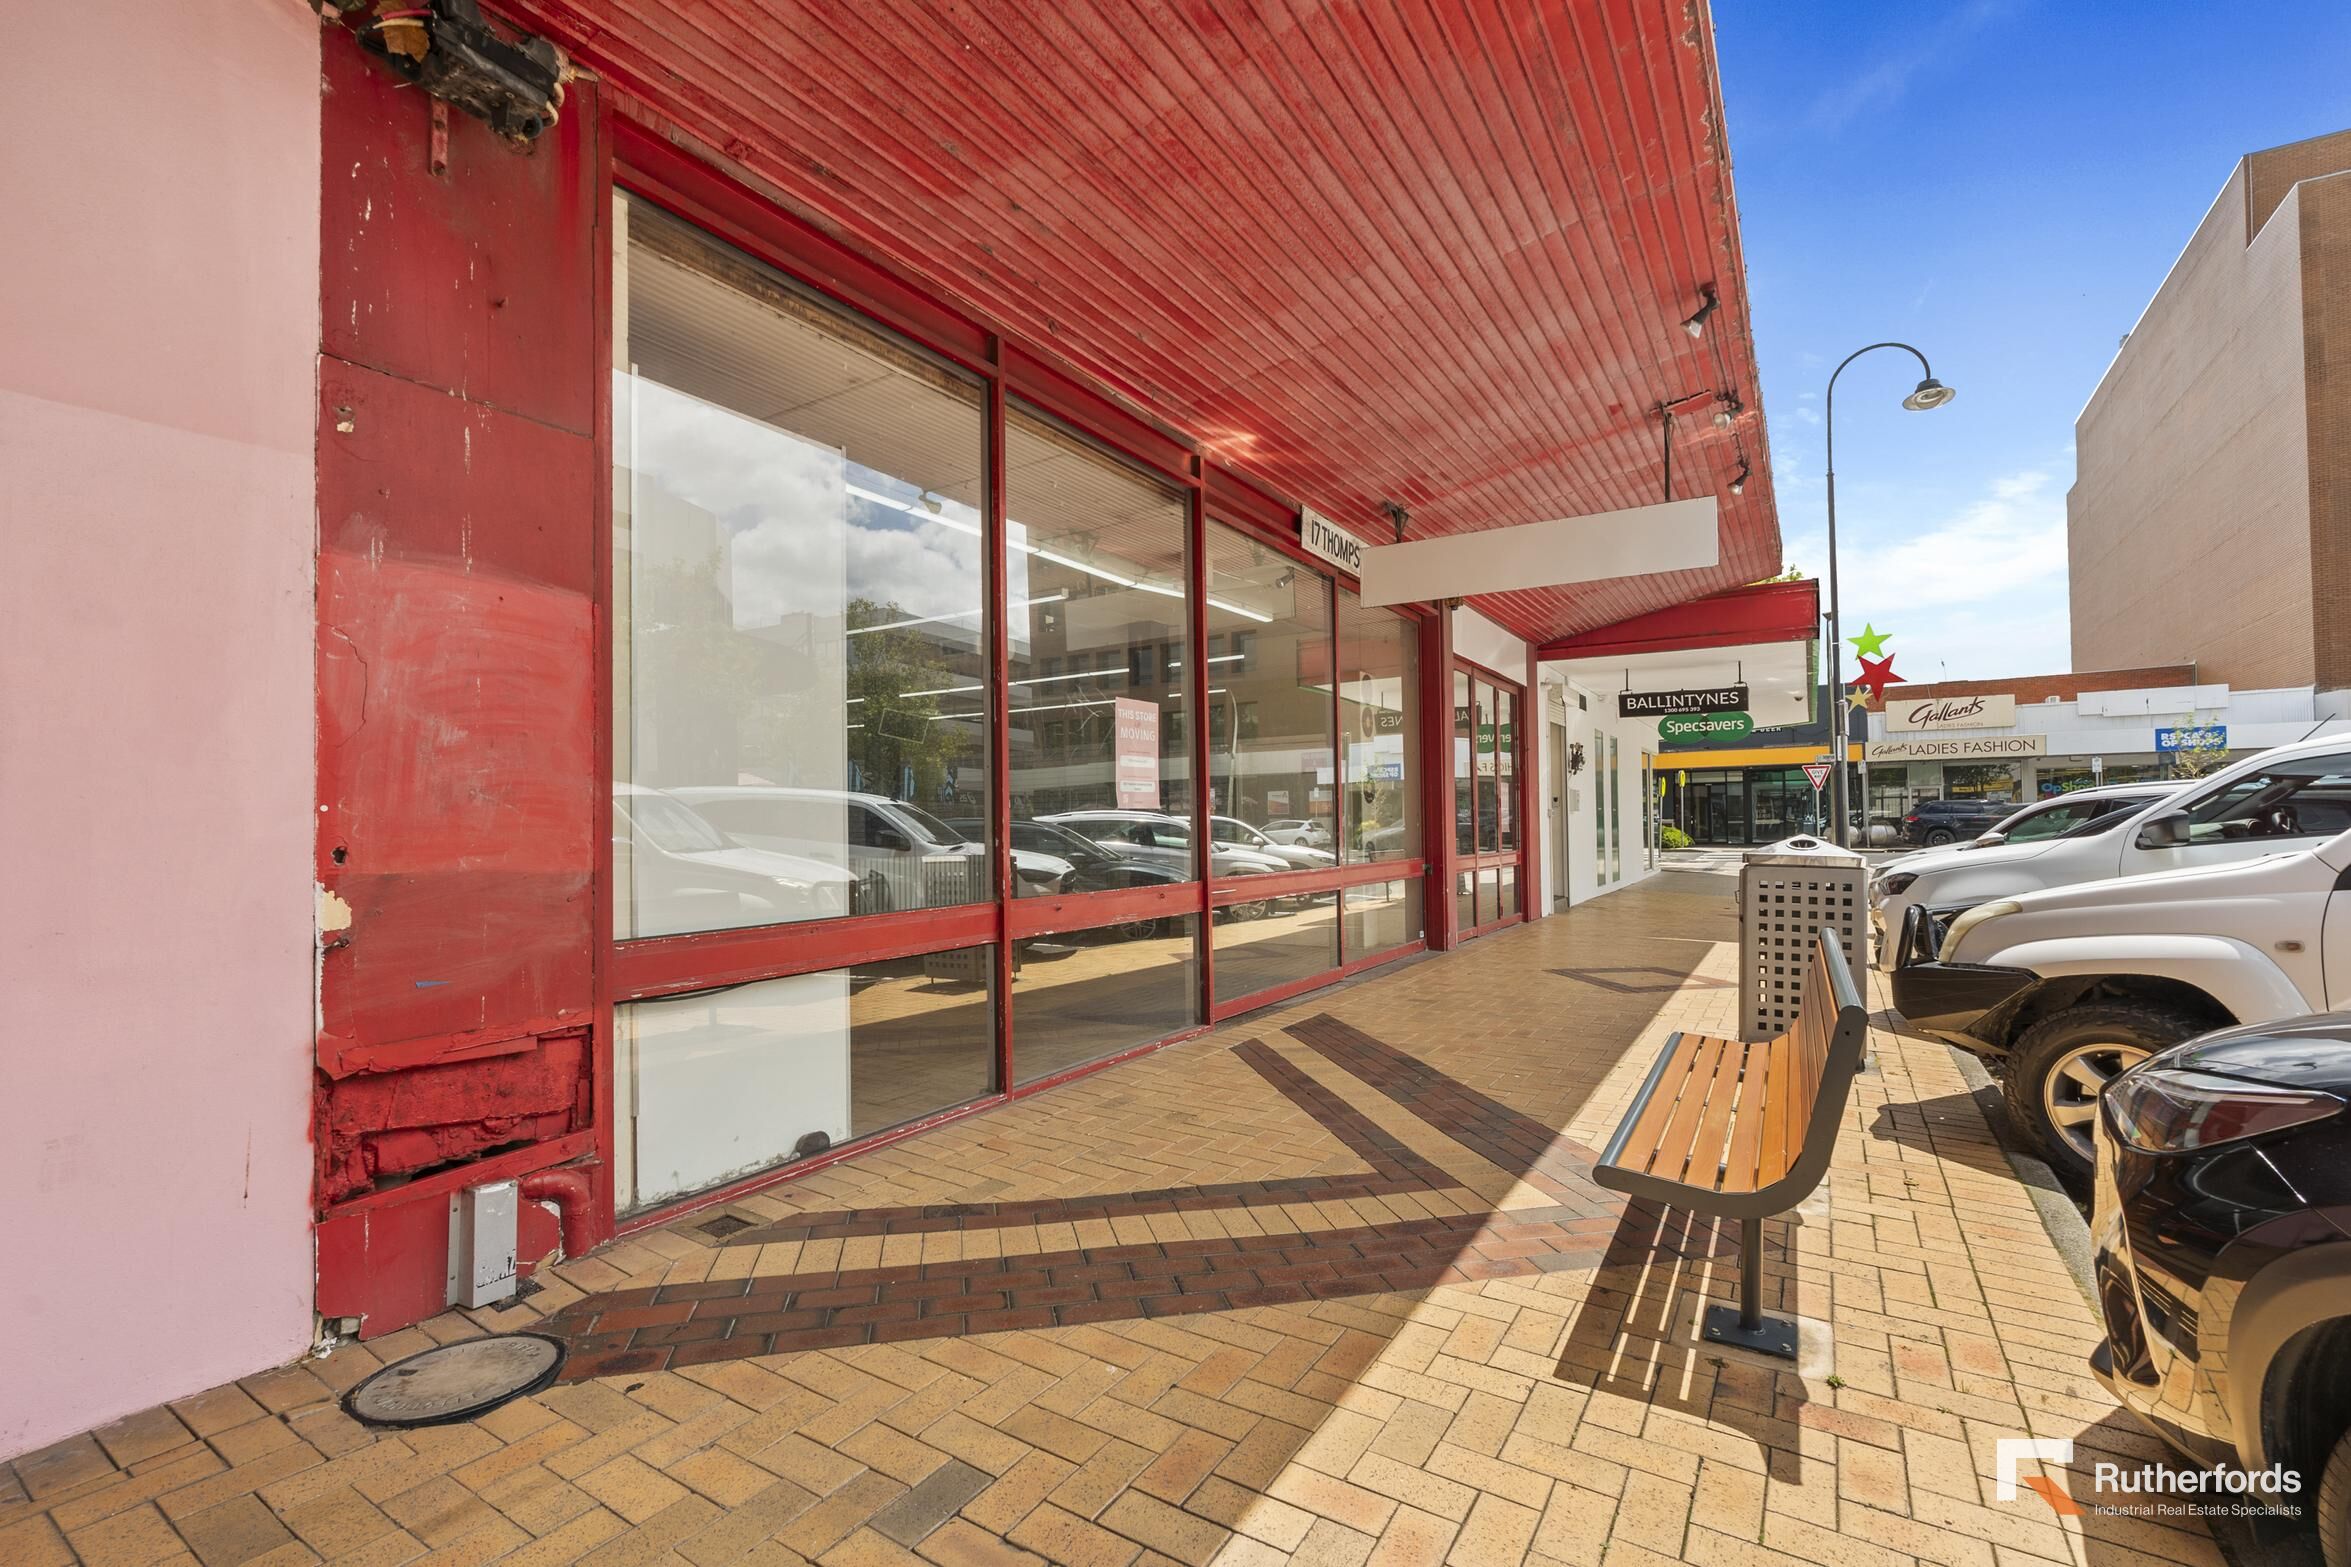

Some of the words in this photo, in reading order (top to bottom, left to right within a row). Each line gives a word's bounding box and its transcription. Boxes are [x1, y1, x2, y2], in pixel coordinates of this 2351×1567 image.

[1312, 520, 1320, 546] 17
[1626, 691, 1739, 710] BALLINTYNES
[1118, 708, 1134, 720] THIS
[1135, 711, 1156, 722] STORE
[1908, 696, 1986, 729] Gallants
[1120, 727, 1155, 742] MOVING
[1666, 719, 1744, 735] Specsavers
[1872, 742, 1907, 758] Gallants
[1909, 743, 1958, 756] LADIES
[1964, 740, 2036, 754] FASHION
